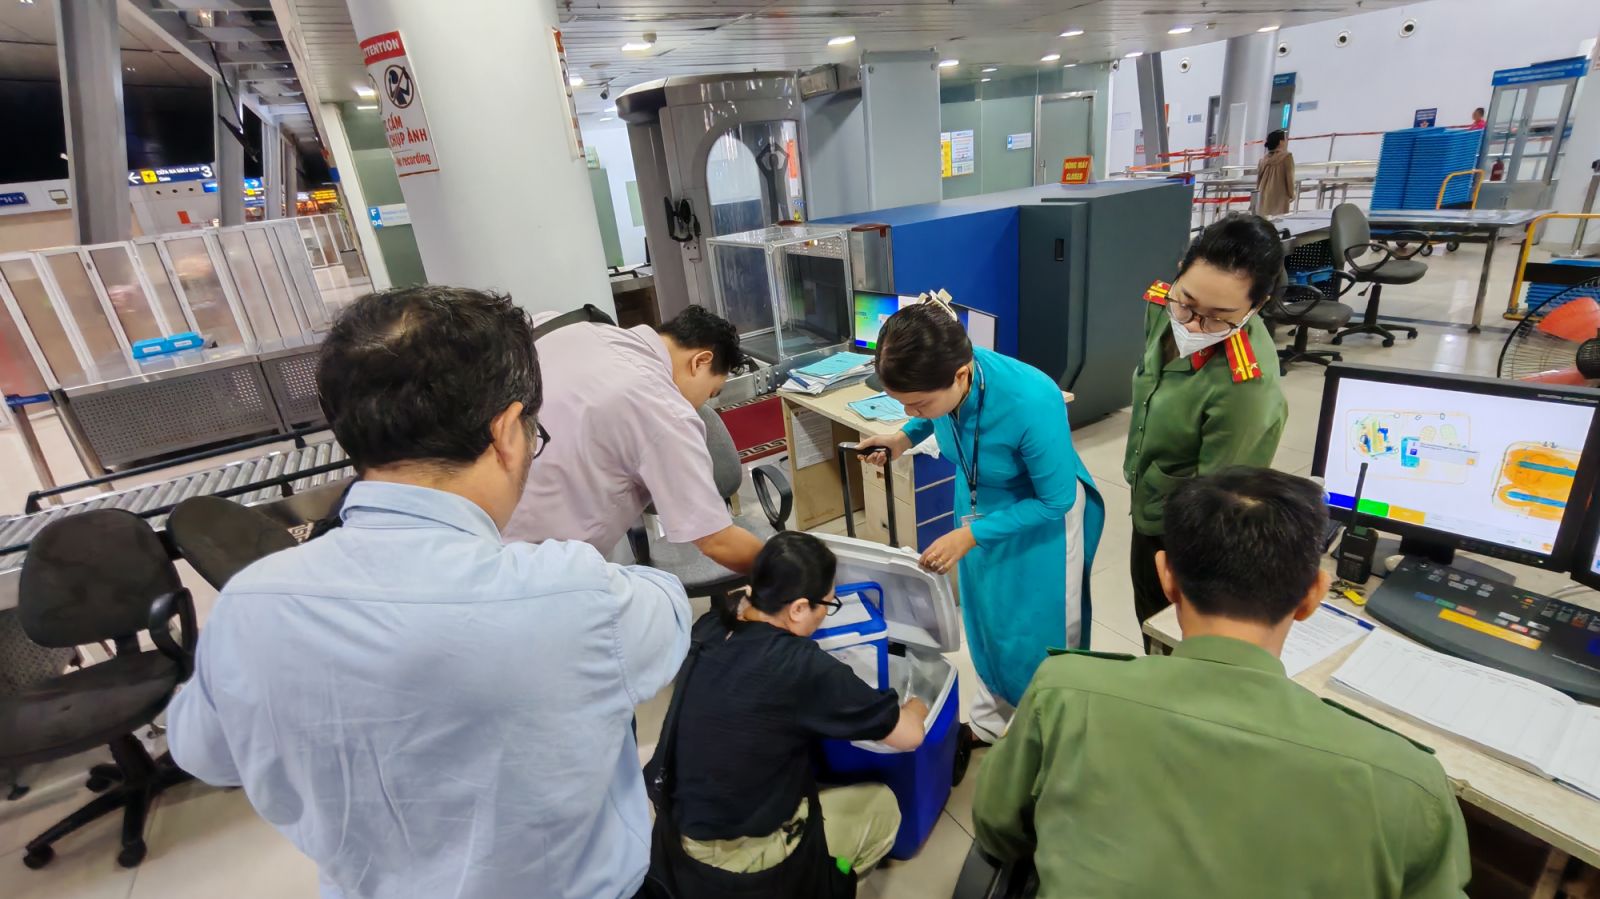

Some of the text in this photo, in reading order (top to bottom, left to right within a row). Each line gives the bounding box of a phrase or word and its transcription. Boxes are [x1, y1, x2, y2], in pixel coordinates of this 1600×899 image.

[402, 152, 431, 166] recording
[201, 165, 213, 178] 3
[370, 208, 377, 217] F
